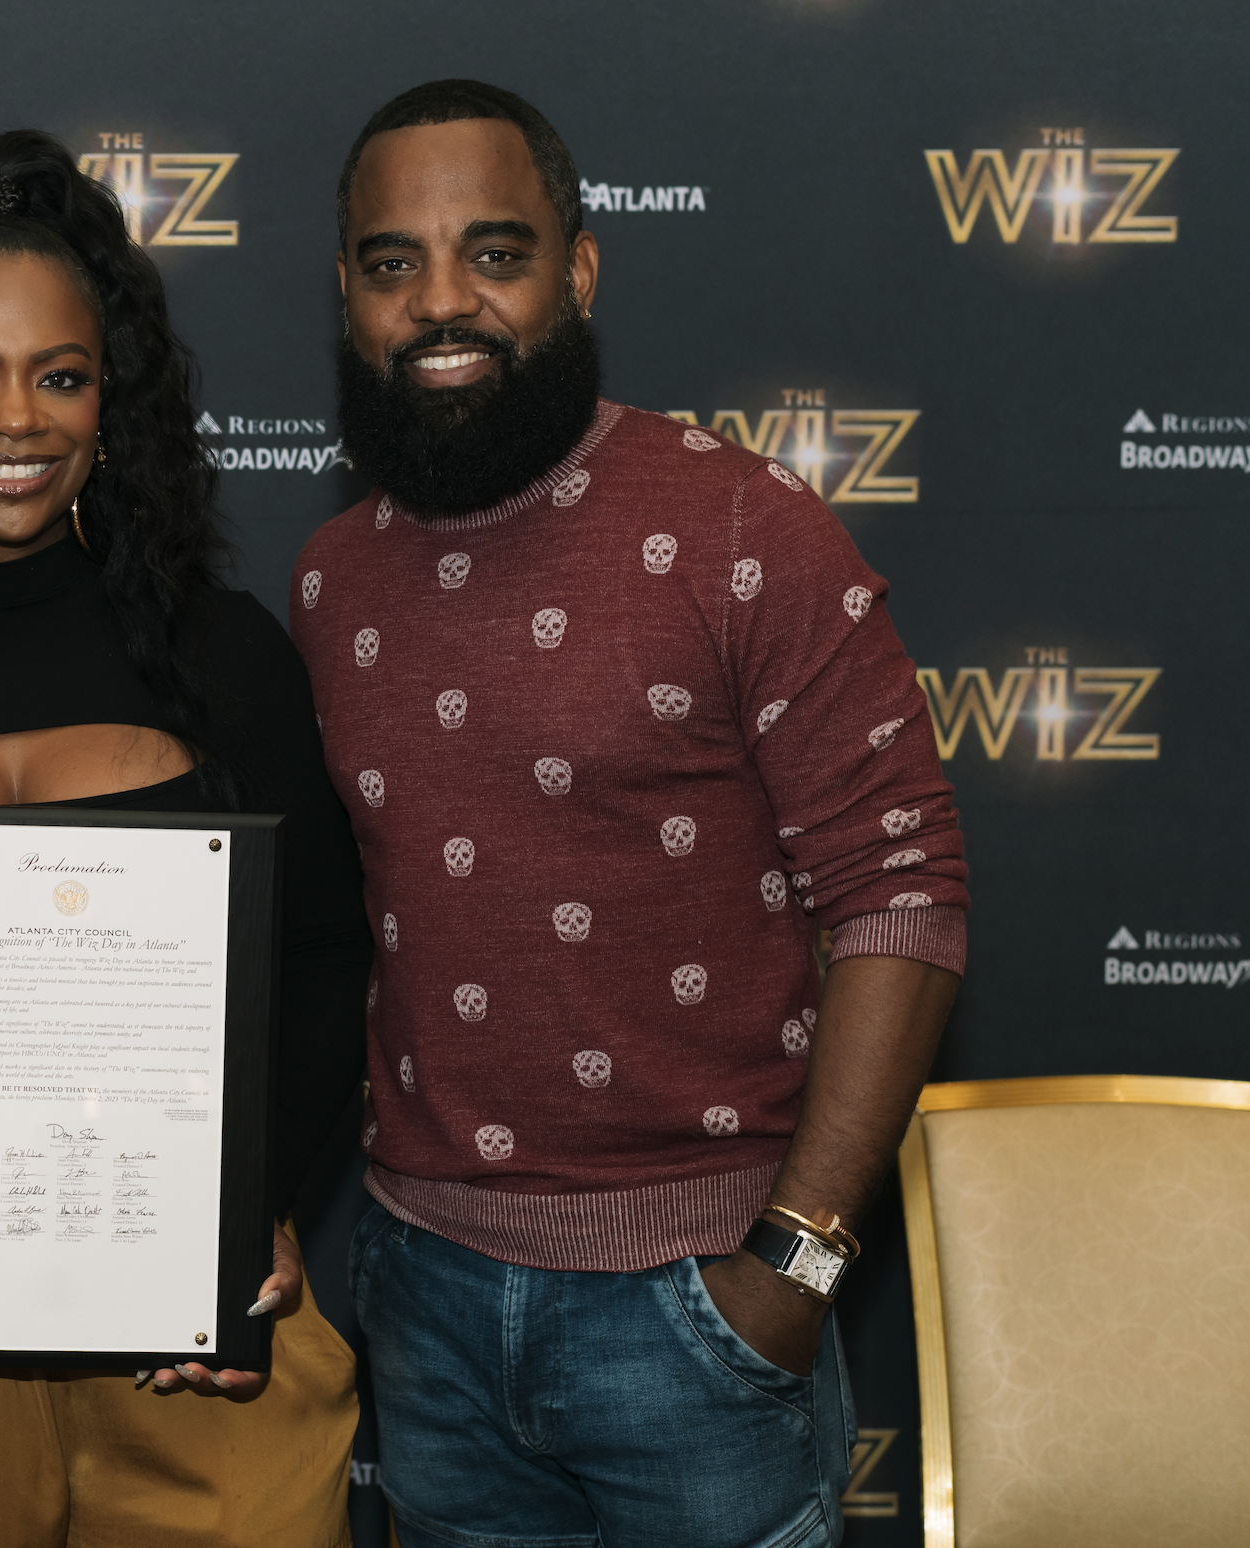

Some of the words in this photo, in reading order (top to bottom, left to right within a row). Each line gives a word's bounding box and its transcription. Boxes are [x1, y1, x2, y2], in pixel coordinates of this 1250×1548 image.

[100, 132, 144, 149] THE
[1040, 127, 1085, 145] THE
[77, 153, 241, 246] IZ
[589, 183, 707, 212] ATLANTA
[924, 147, 1182, 244] WIZ
[781, 388, 826, 406] THE
[228, 415, 327, 435] REGIONS
[1024, 646, 1069, 665] THE
[916, 667, 1163, 761] WIZ
[18, 853, 129, 874] Proclamation
[58, 928, 81, 936] CITY
[85, 929, 132, 937] COUNCIL
[1145, 930, 1242, 950] REGIONS
[35, 936, 46, 950] of
[49, 936, 72, 947] “The
[76, 938, 99, 951] Wiz
[101, 938, 123, 952] Day
[126, 938, 136, 949] in
[138, 939, 186, 950] Atlanta”
[1104, 957, 1243, 989] BROADWAY
